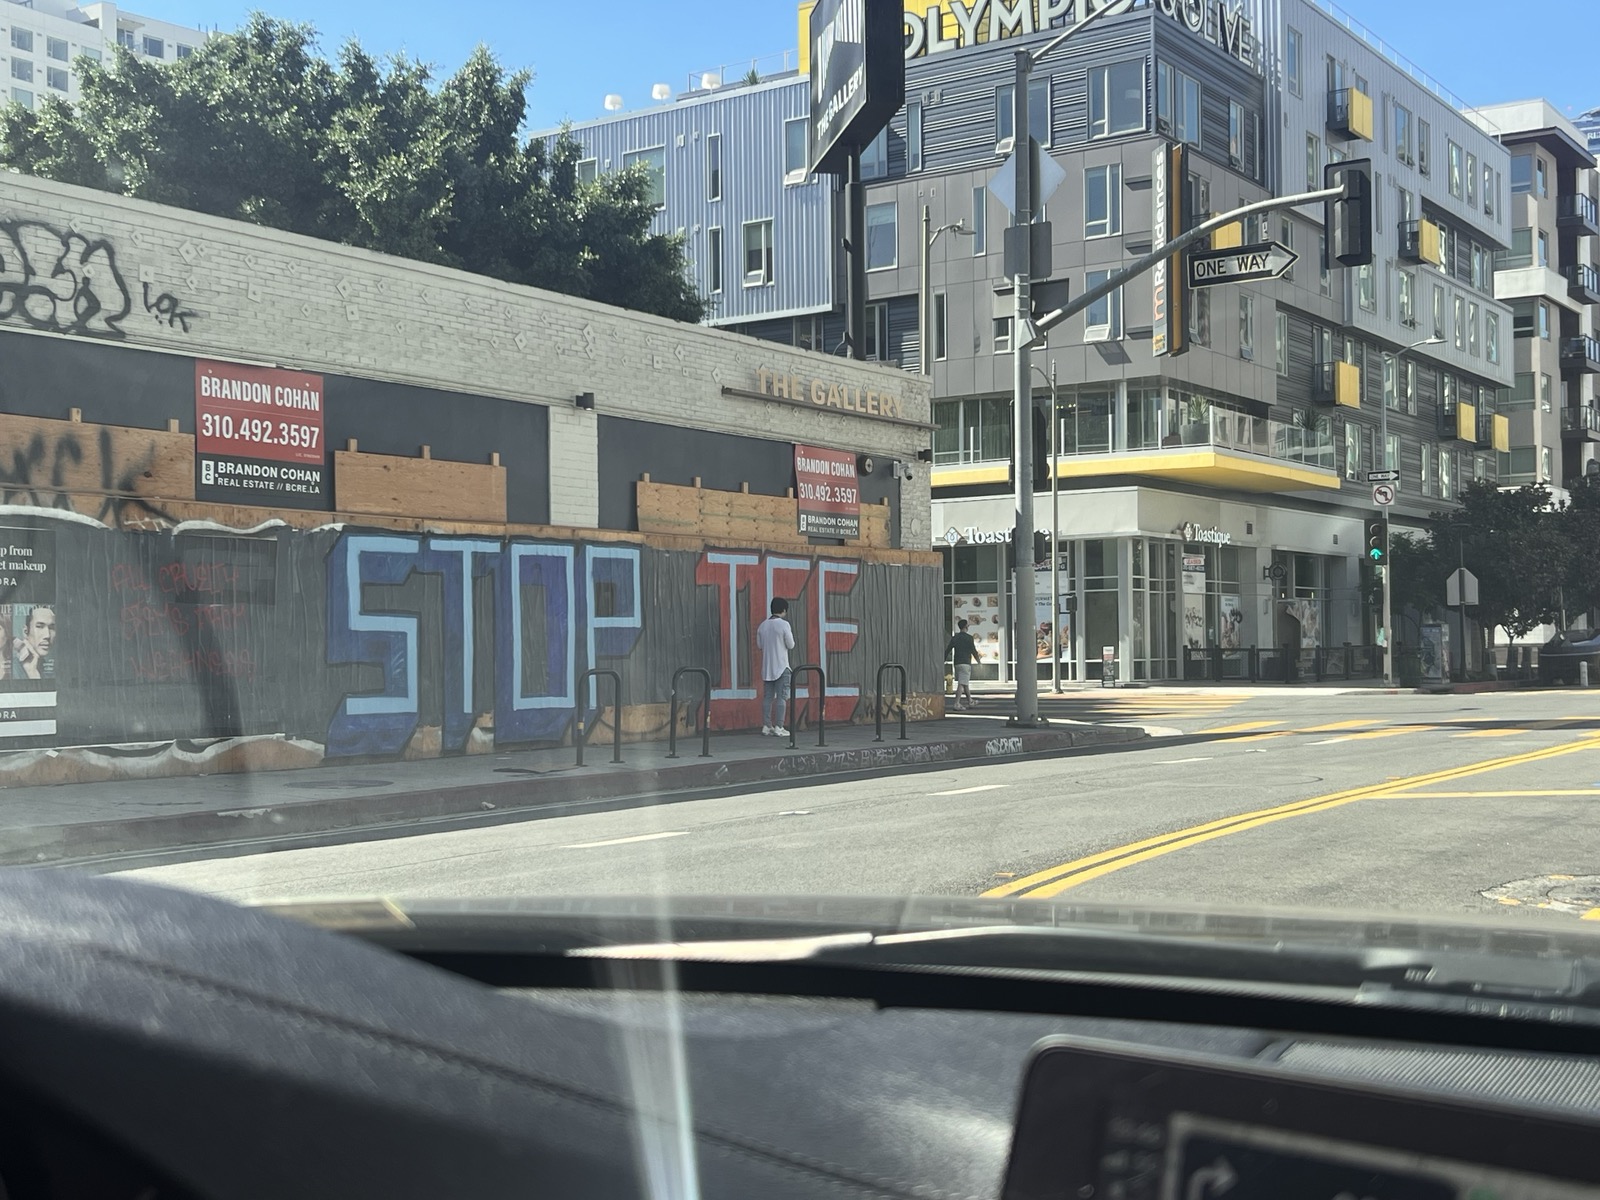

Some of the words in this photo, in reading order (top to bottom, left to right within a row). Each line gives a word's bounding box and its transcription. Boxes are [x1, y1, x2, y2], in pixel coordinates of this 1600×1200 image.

[828, 62, 864, 122] GALLERY
[1196, 258, 1227, 278] ONE
[1237, 252, 1269, 272] WAY
[201, 375, 272, 405] BRANDON
[275, 386, 320, 411] COHAN
[756, 367, 804, 401] THE
[811, 378, 901, 419] GALLERY
[202, 413, 320, 449] 310.492.3597
[217, 461, 278, 478] BRANDON
[280, 468, 320, 482] COHAN
[797, 456, 830, 476] BRANDON
[831, 461, 855, 479] COHAN
[217, 477, 240, 488] REAL
[243, 479, 274, 490] ESTATE
[285, 483, 320, 494] BCRE.LA
[800, 482, 857, 504] 310.492.3597
[807, 515, 836, 526] BRANDON
[837, 518, 858, 528] COHAN
[820, 526, 835, 534] ESTATE
[1194, 523, 1231, 549] Toastique
[9, 545, 33, 557] from
[9, 560, 47, 573] makeup
[326, 533, 643, 756] STOP
[697, 548, 861, 731] ICE
